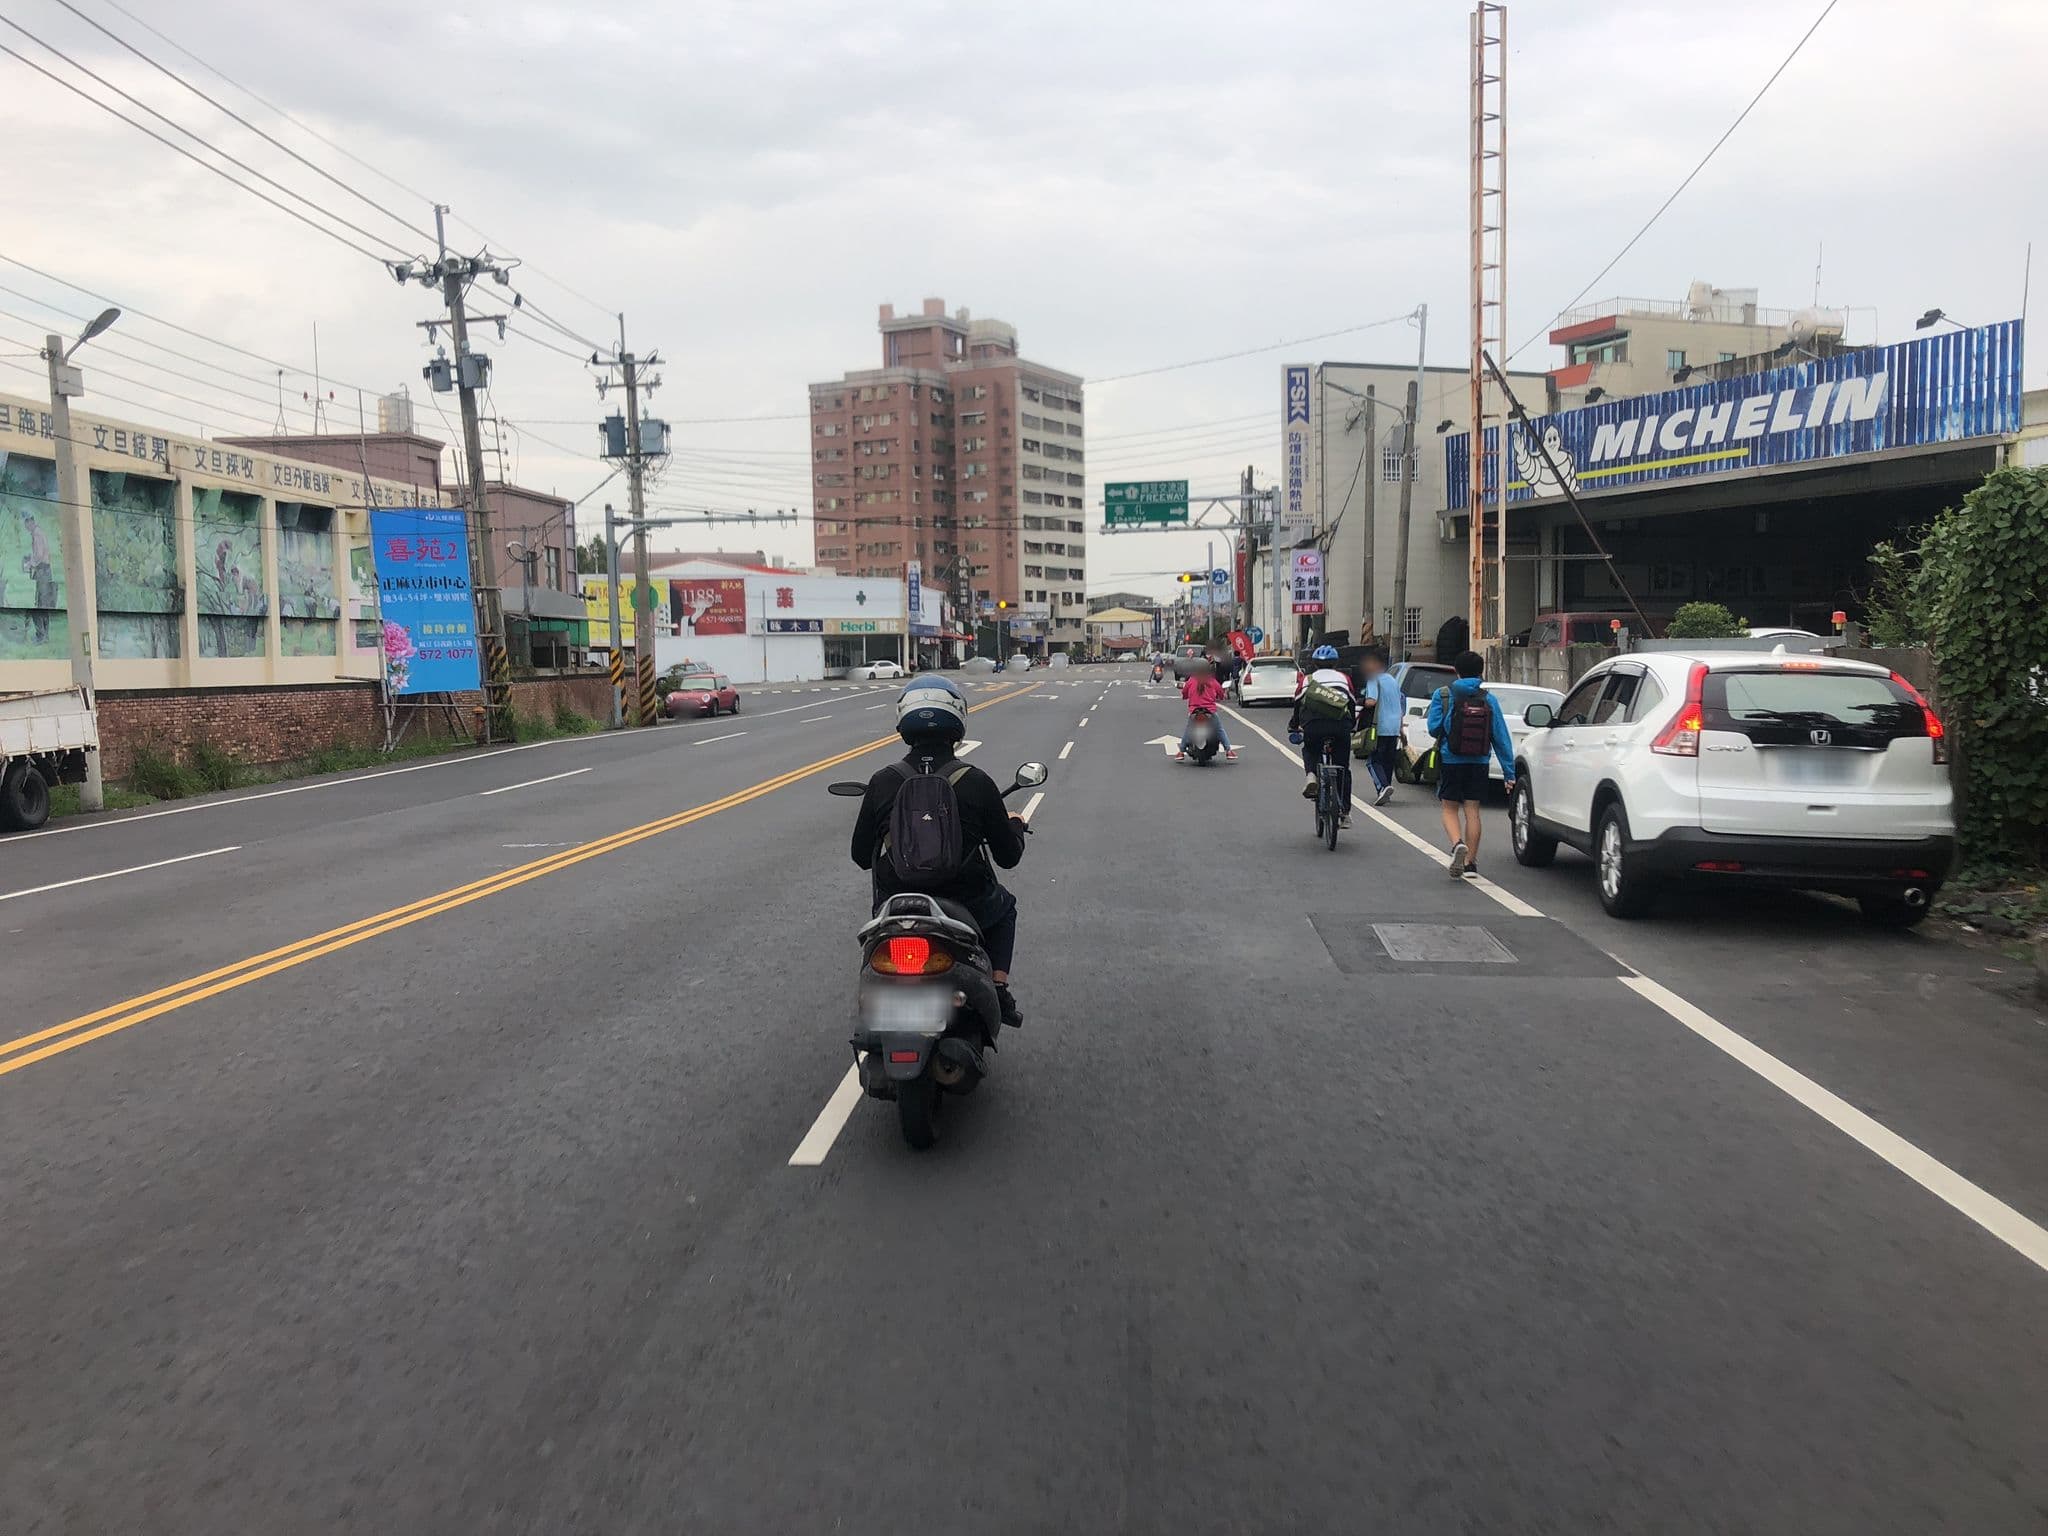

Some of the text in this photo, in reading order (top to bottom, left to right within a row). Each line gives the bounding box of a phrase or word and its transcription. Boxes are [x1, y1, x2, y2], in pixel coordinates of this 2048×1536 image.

[1290, 371, 1306, 417] FSK
[1590, 371, 1888, 463] MICHELIN
[93, 424, 167, 463] 文旦結果
[195, 446, 254, 480] 文旦採收
[273, 463, 331, 494] 文旦分級包裝
[1140, 493, 1184, 503] FREEWAY
[840, 621, 876, 632] Herbi
[419, 648, 474, 660] 572 1077
